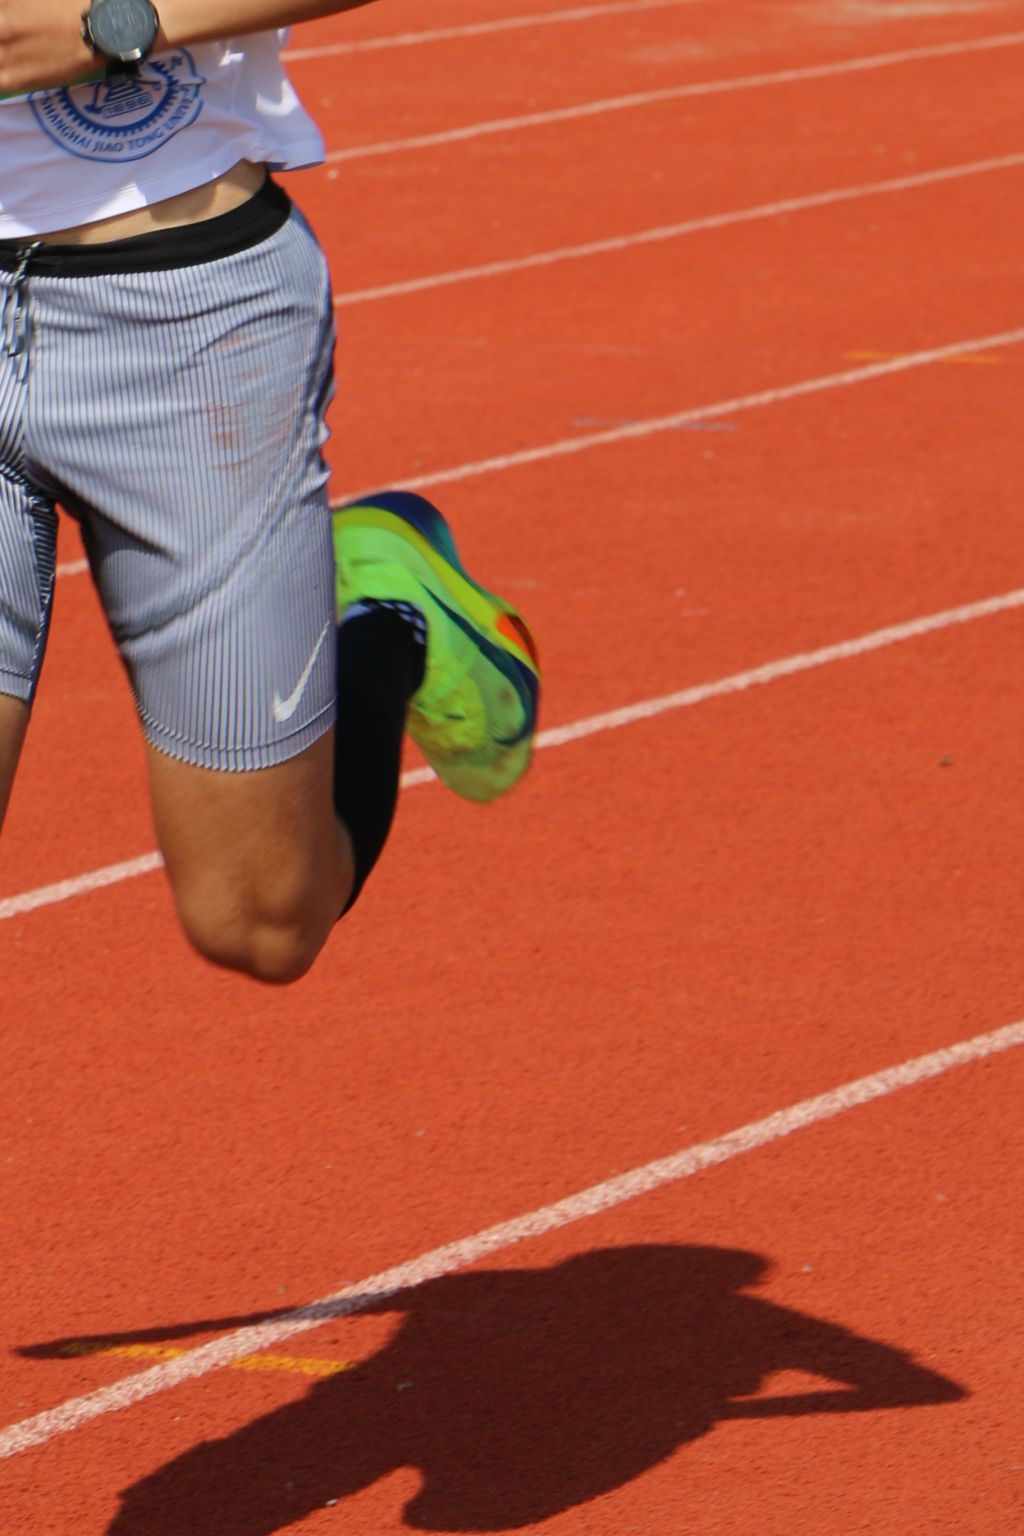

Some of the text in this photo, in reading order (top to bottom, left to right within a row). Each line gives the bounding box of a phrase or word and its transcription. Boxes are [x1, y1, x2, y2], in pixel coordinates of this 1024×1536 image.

[42, 96, 91, 150] SHANGHAI
[92, 141, 125, 152] JIAO
[128, 128, 163, 150] TONG
